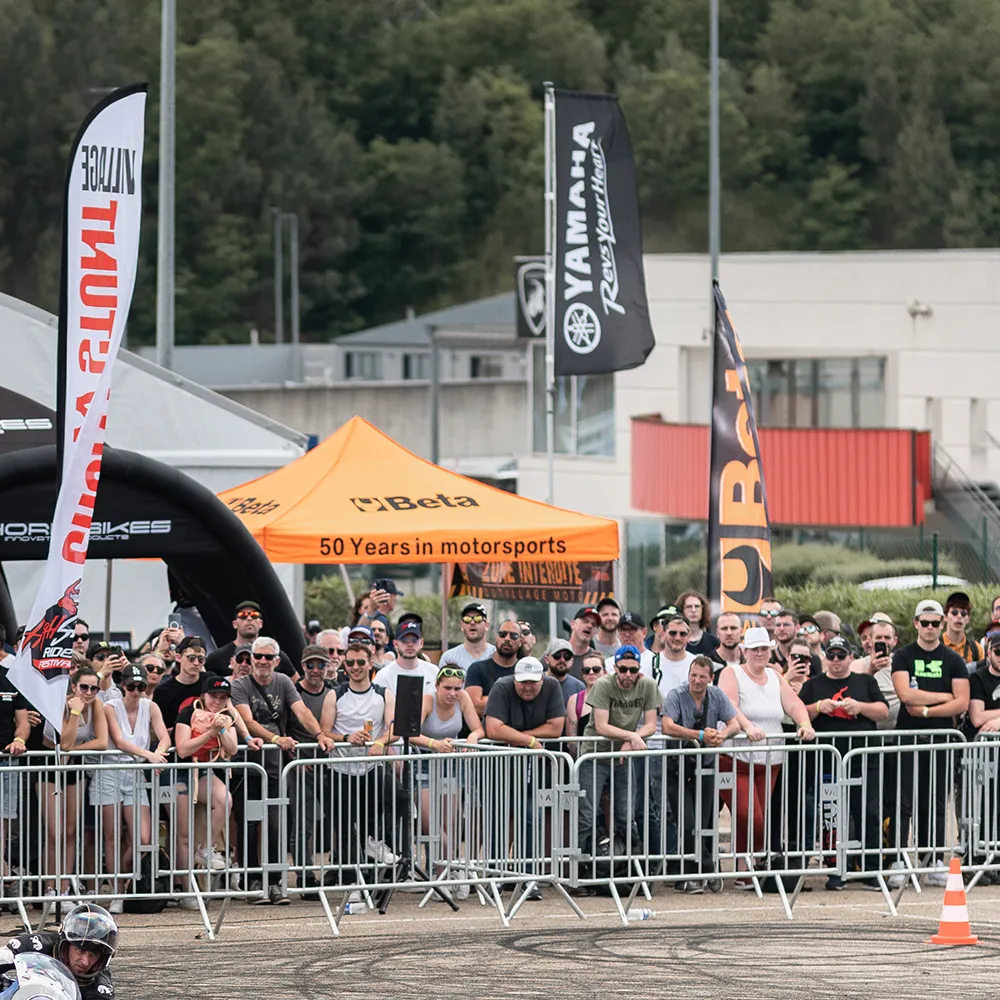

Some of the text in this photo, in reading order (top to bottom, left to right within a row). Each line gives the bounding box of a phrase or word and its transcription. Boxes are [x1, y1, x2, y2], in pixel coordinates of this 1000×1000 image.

[564, 121, 595, 300] YAMAHA
[595, 193, 617, 245] Your
[390, 493, 480, 511] Beta
[4, 534, 51, 542] INNOVAT
[320, 536, 567, 560] 50 Years in motorsports
